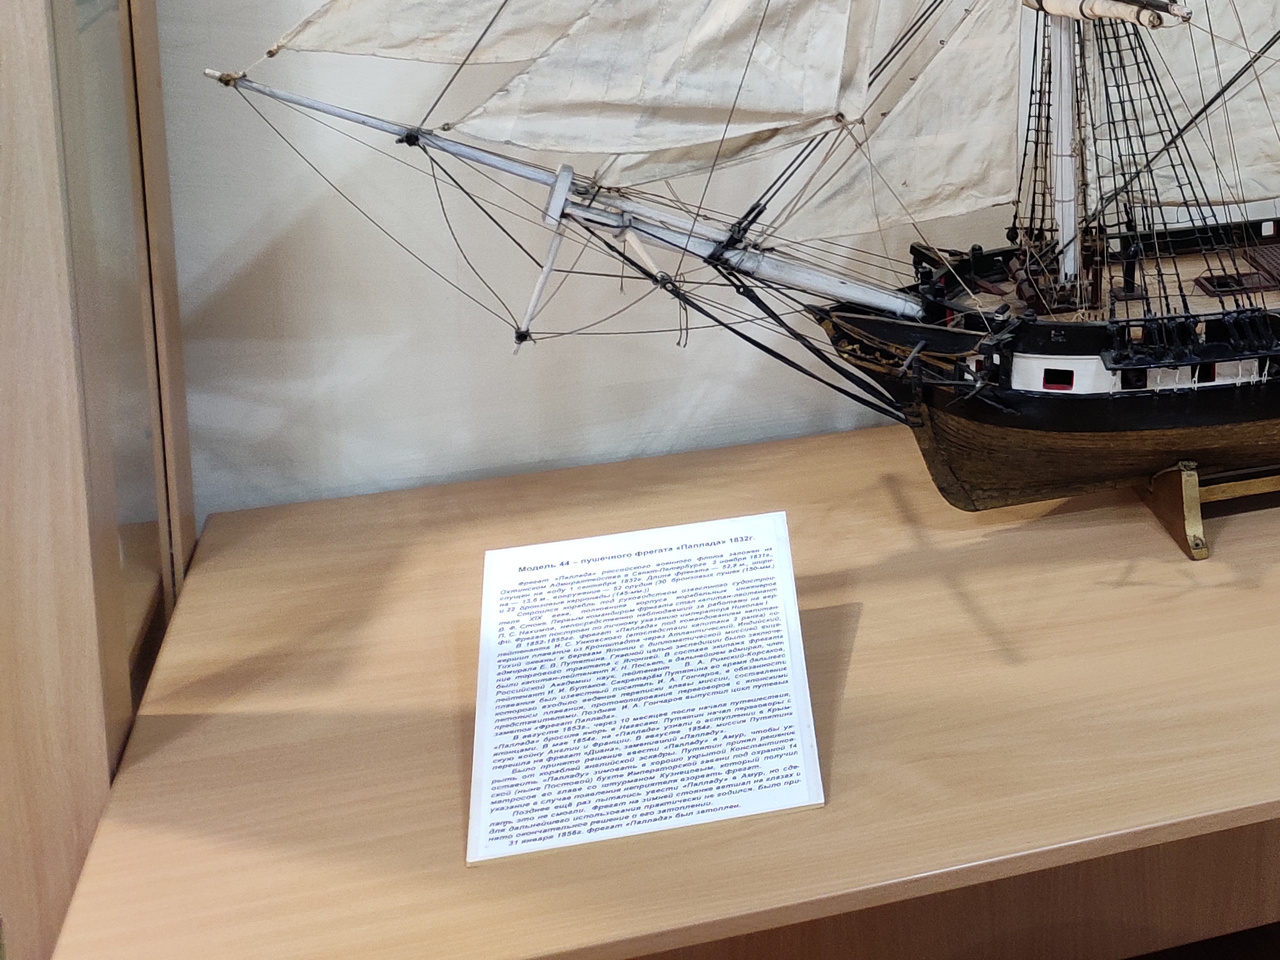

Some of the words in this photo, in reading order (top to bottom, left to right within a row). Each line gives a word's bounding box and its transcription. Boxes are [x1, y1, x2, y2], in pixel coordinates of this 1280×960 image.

[518, 562, 555, 573] Модель
[580, 552, 631, 564] пушечного
[634, 546, 672, 556] фрегата
[676, 539, 725, 551] «Паллада»
